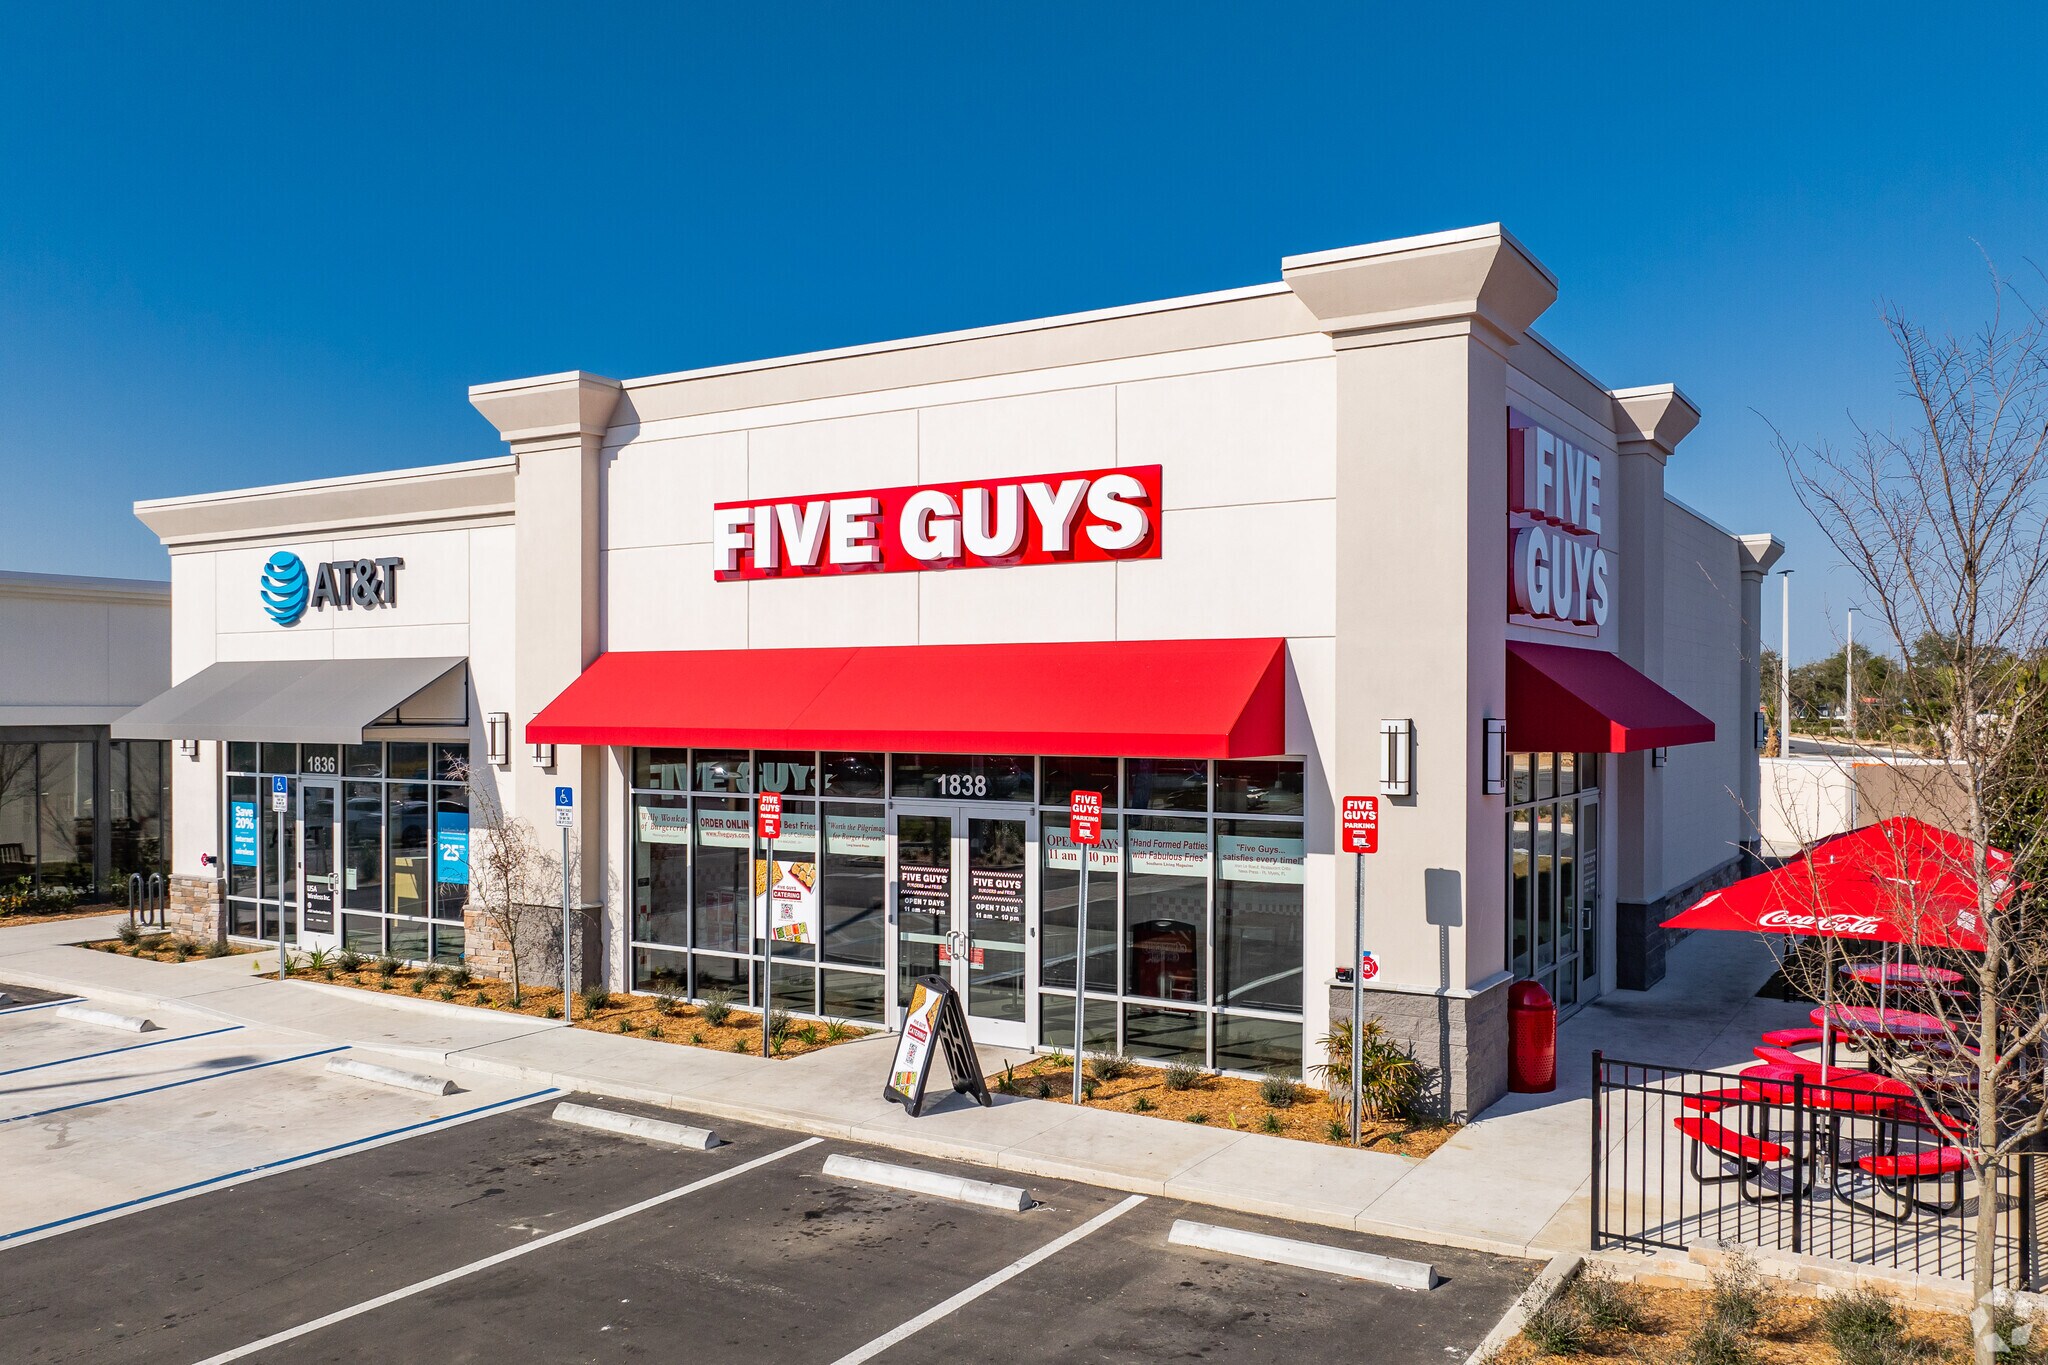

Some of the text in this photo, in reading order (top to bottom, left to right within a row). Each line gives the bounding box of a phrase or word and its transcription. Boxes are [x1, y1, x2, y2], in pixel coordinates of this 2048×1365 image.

[1531, 426, 1601, 535] FIVE
[714, 473, 1149, 571] FIVE GUYS
[1521, 526, 1608, 626] GUYS
[311, 557, 404, 609] AT&T
[307, 756, 335, 773] 1836
[937, 773, 987, 797] 1838
[762, 795, 778, 804] FIVE
[1075, 794, 1098, 805] FIVE
[1347, 800, 1373, 810] FIVE
[235, 806, 253, 817] Save
[760, 804, 780, 812] GUYS
[1072, 804, 1100, 814] GUYS
[1343, 810, 1377, 821] GUYS
[235, 817, 254, 829] 20%
[640, 822, 688, 834] of Burgercraf
[700, 817, 749, 830] ORDER ONLIN
[784, 821, 798, 830] Best
[847, 822, 856, 831] the
[857, 823, 886, 833] Pilgrimag
[842, 833, 860, 842] Burger
[1153, 839, 1181, 849] Formed
[1183, 840, 1208, 850] Patties
[1049, 848, 1118, 865] 11 am 10 pm
[1132, 850, 1147, 859] with
[1148, 851, 1182, 861] Fabulous
[1222, 854, 1253, 863] satisfies
[1256, 856, 1278, 865] every
[901, 872, 948, 883] FIVE GUYS
[973, 878, 1021, 889] FIVE GUYS
[904, 897, 922, 905] OPEN
[928, 899, 945, 907] DAYS
[1001, 905, 1019, 913] DAYS
[1759, 910, 1884, 935] Coca-Cola
